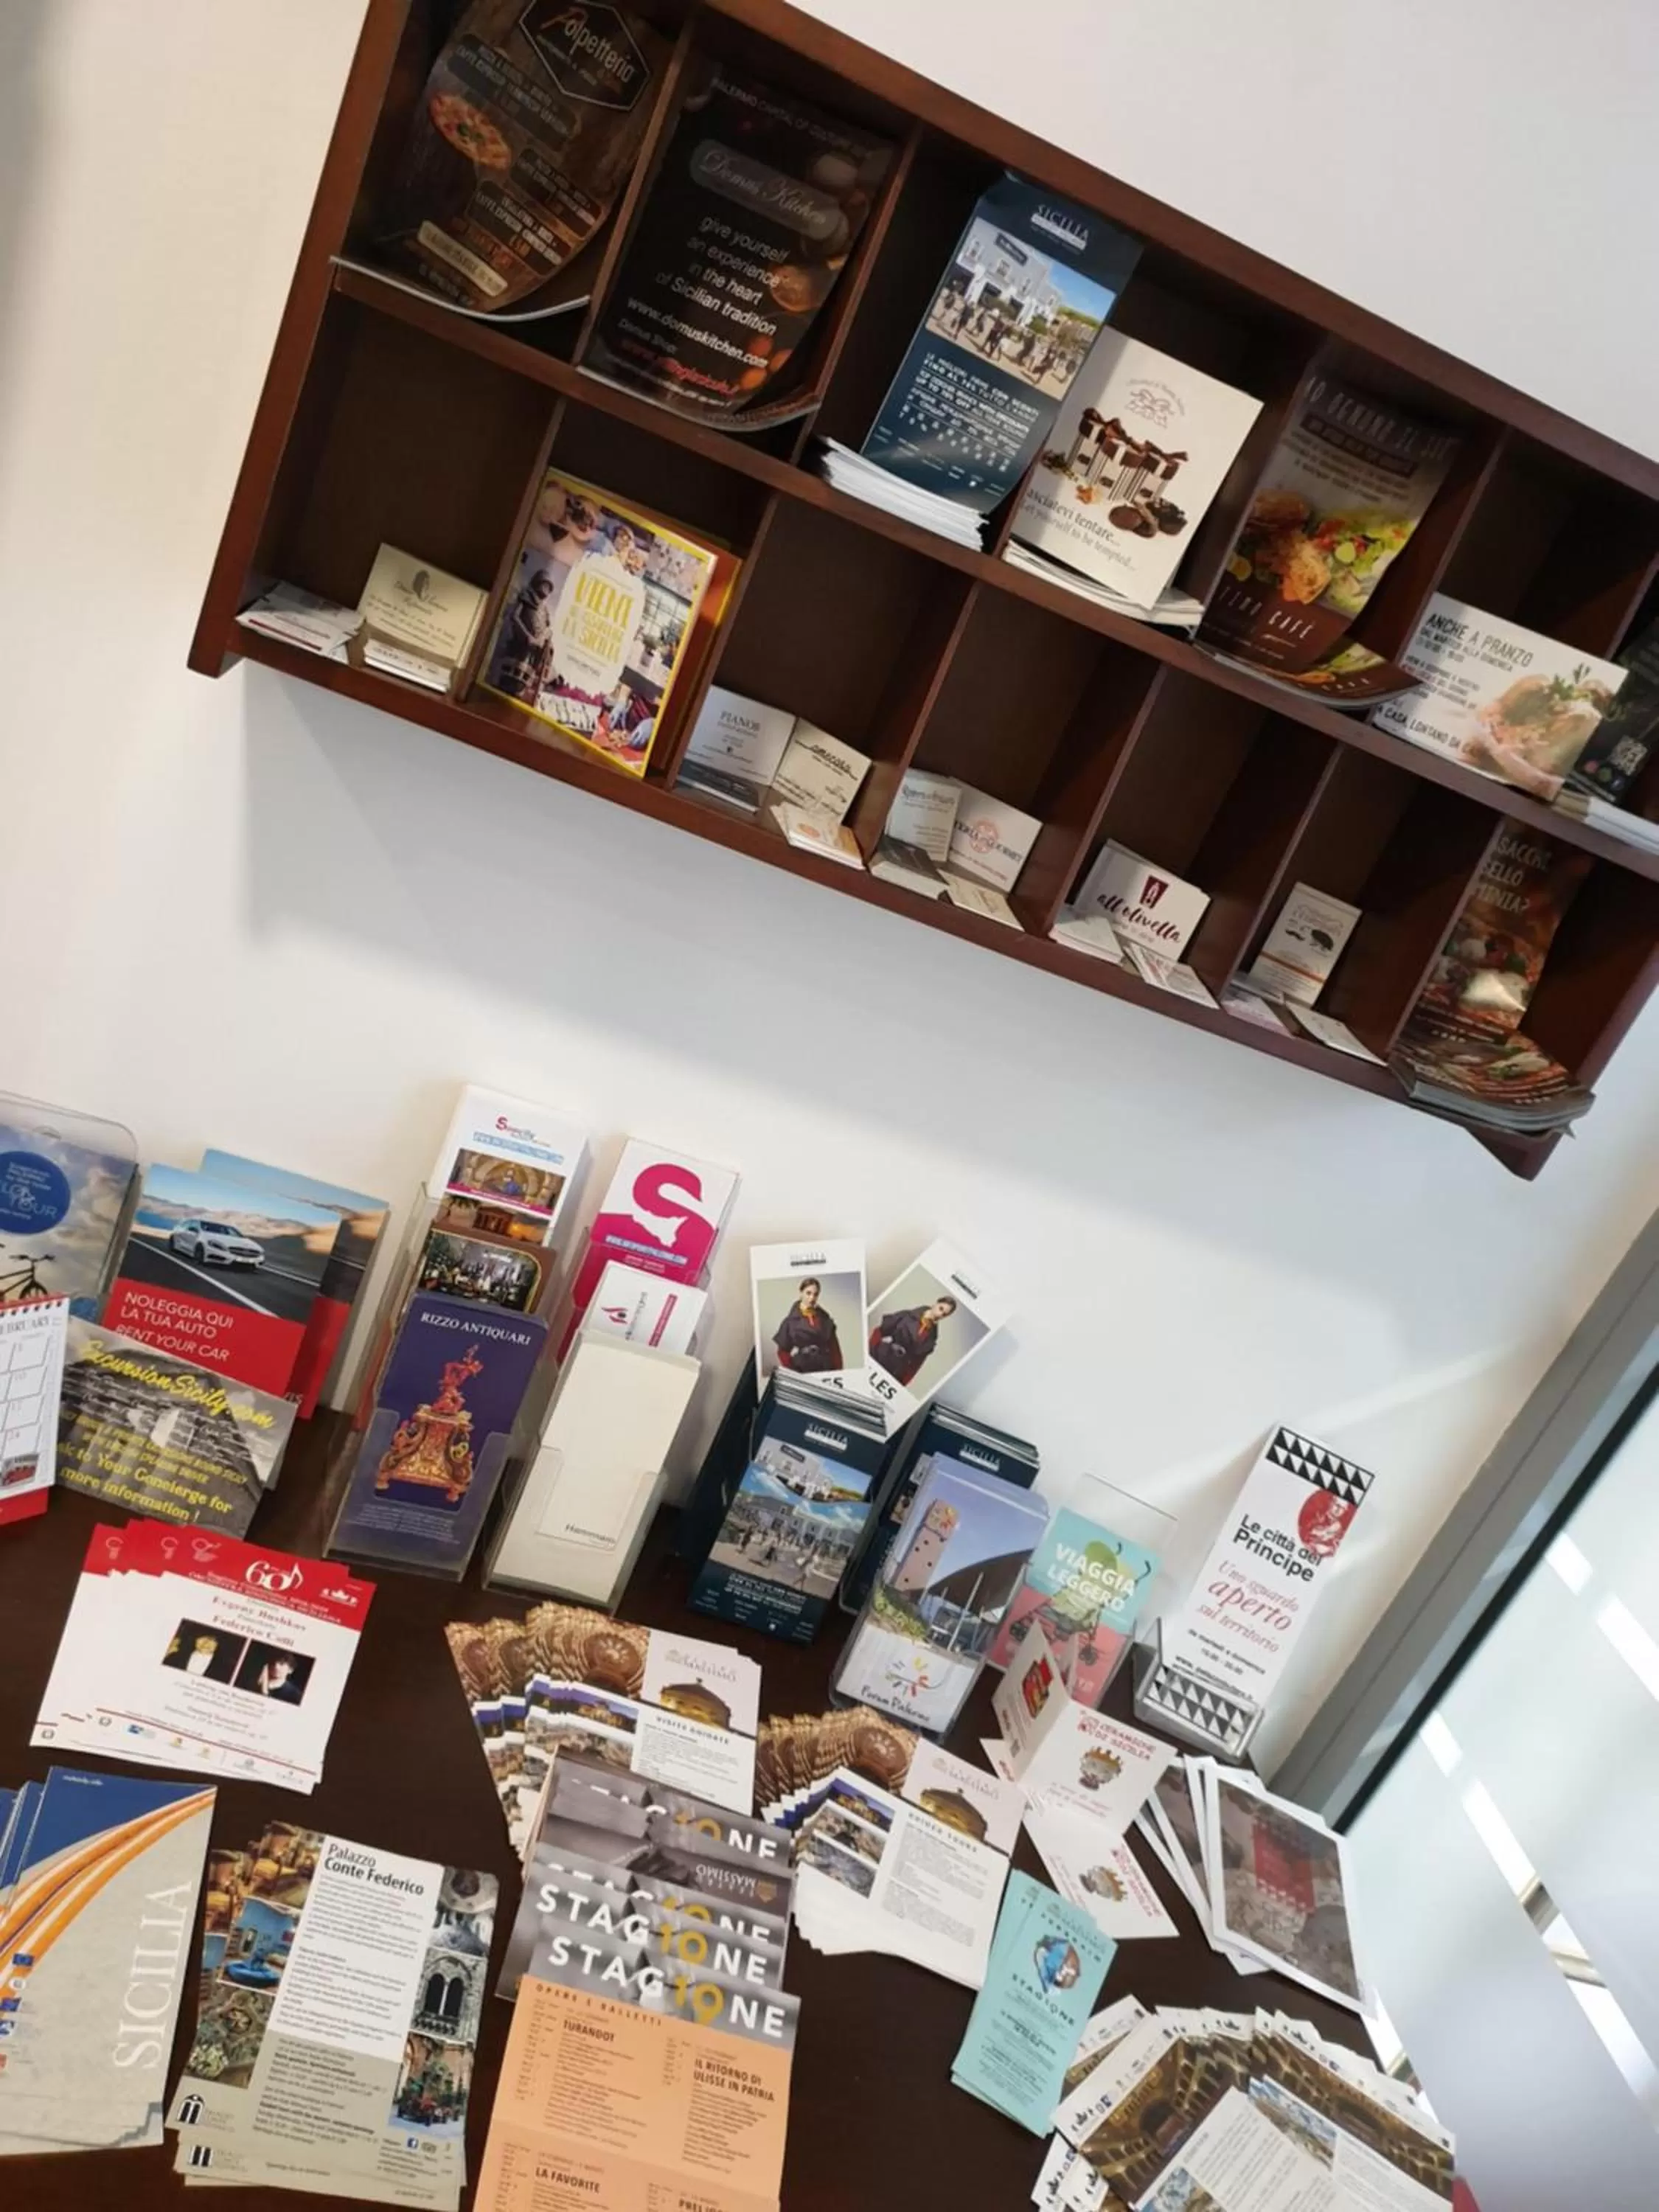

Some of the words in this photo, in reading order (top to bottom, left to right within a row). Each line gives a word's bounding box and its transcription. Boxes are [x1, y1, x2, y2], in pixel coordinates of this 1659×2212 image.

[699, 215, 731, 240] give
[733, 229, 790, 263] yourself
[686, 235, 706, 254] an
[706, 243, 779, 289] experience
[672, 275, 720, 313] Sicilian
[723, 300, 778, 336] tradition
[701, 265, 725, 289] the
[724, 274, 764, 308] heart
[626, 296, 770, 369] www.domuskitchen.com
[1426, 613, 1470, 640] ANCHE
[1469, 630, 1481, 645] A
[1481, 635, 1534, 668] PRANZO
[120, 1305, 142, 1322] LA
[143, 1310, 172, 1329] TUA
[175, 1318, 218, 1340] AUTO
[125, 1291, 204, 1322] NOLEGGIA
[206, 1308, 235, 1330] QUI
[421, 1312, 460, 1329] RIZZO
[461, 1320, 532, 1346] ANTIQUARI
[115, 1324, 153, 1346] RENT
[155, 1333, 195, 1354] YOUR
[198, 1342, 229, 1362] CAR
[61, 1467, 101, 1489] more
[102, 1478, 190, 1522] information
[98, 1453, 133, 1475] Your
[133, 1467, 208, 1506] Concierge
[209, 1495, 234, 1514] for
[1232, 1529, 1315, 1583] Principe
[1239, 1513, 1262, 1537] Le
[1262, 1523, 1297, 1553] città
[1297, 1542, 1324, 1568] del
[1046, 1563, 1126, 1613] LEGGERO
[1055, 1543, 1136, 1598] VIAGGIA
[1207, 1577, 1294, 1632] aperto
[1247, 1576, 1300, 1613] sguardo
[212, 1615, 265, 1638] Federico
[323, 1857, 366, 1882] Conte
[366, 1868, 425, 1896] Federico
[327, 1843, 378, 1868] Palazzo
[113, 1880, 192, 2070] SICILIA
[563, 2019, 616, 2042] TURANDOT
[693, 2069, 727, 2090] ULISSE
[741, 2084, 776, 2103] PATRIA
[705, 2060, 749, 2082] RITORNO
[550, 2170, 602, 2194] FAVORITE
